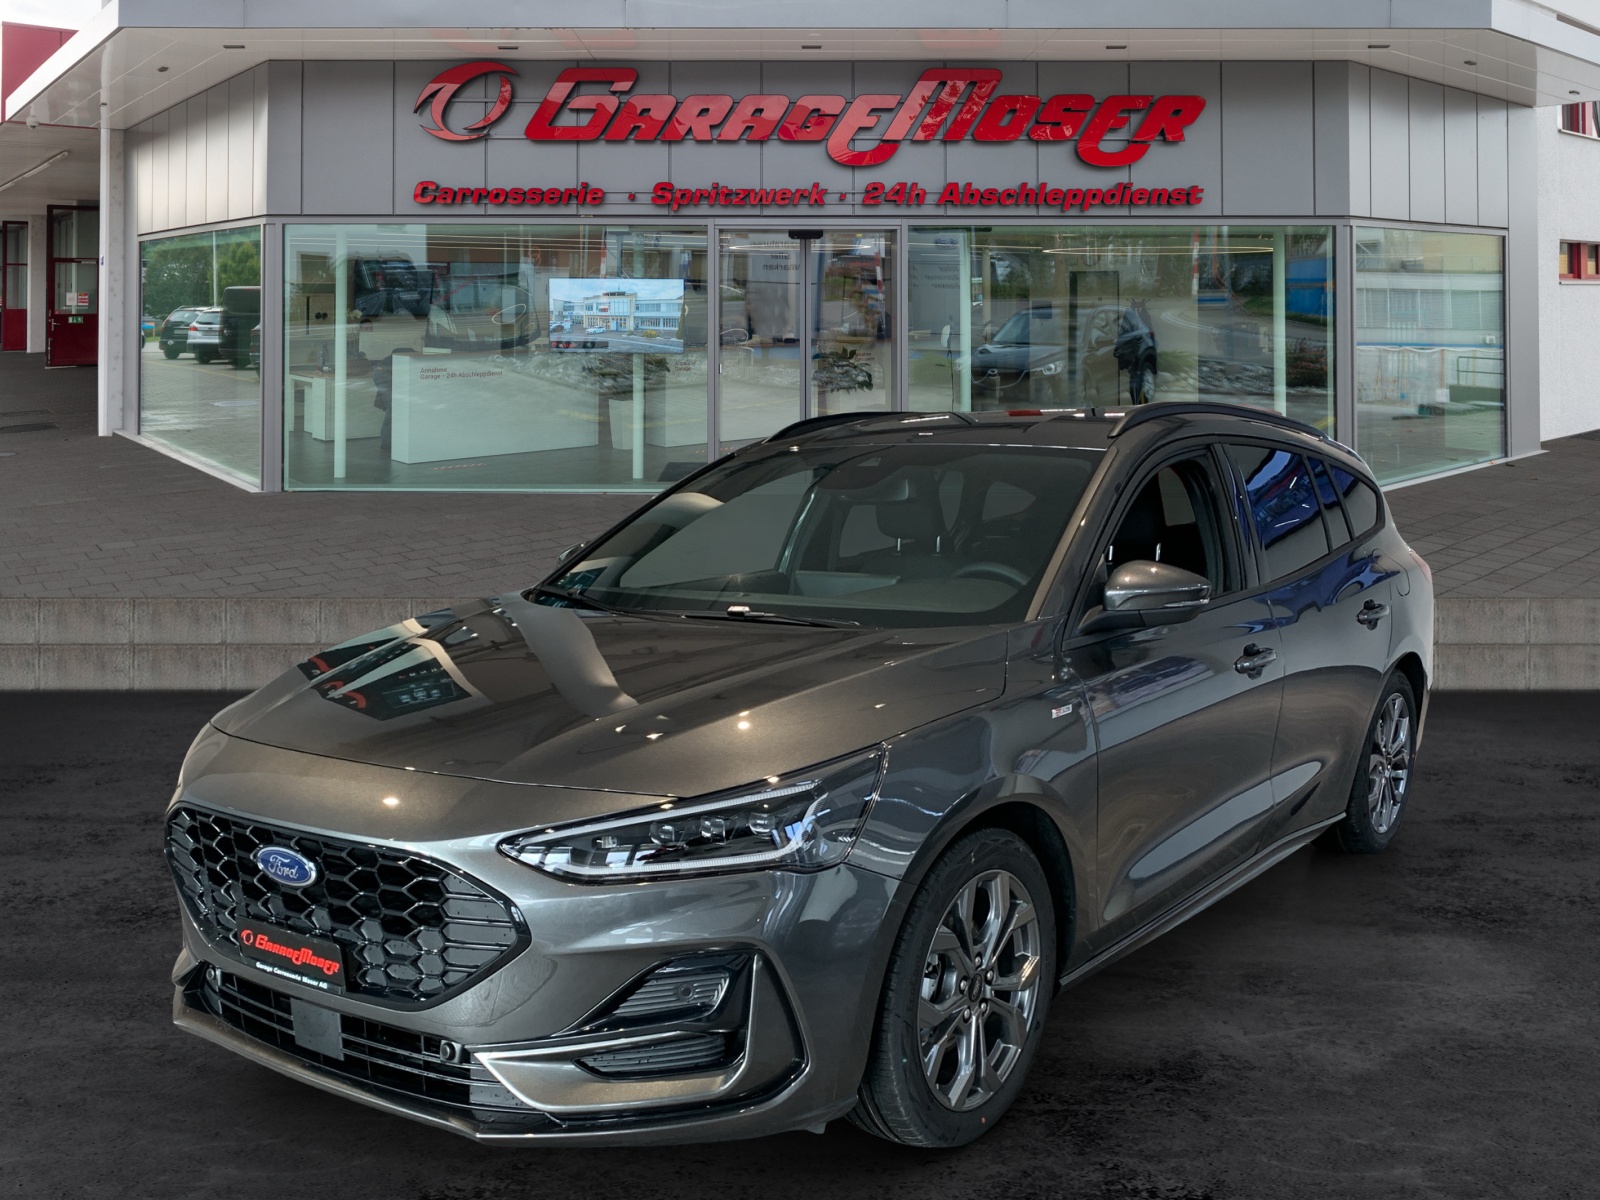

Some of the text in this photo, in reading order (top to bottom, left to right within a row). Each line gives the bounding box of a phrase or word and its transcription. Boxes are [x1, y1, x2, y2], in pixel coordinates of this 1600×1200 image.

[413, 181, 1204, 211] Carrosserie Spritzwerk 24h Abschleppdienst
[458, 371, 503, 379] Abschleppdienst
[268, 854, 299, 879] Ford
